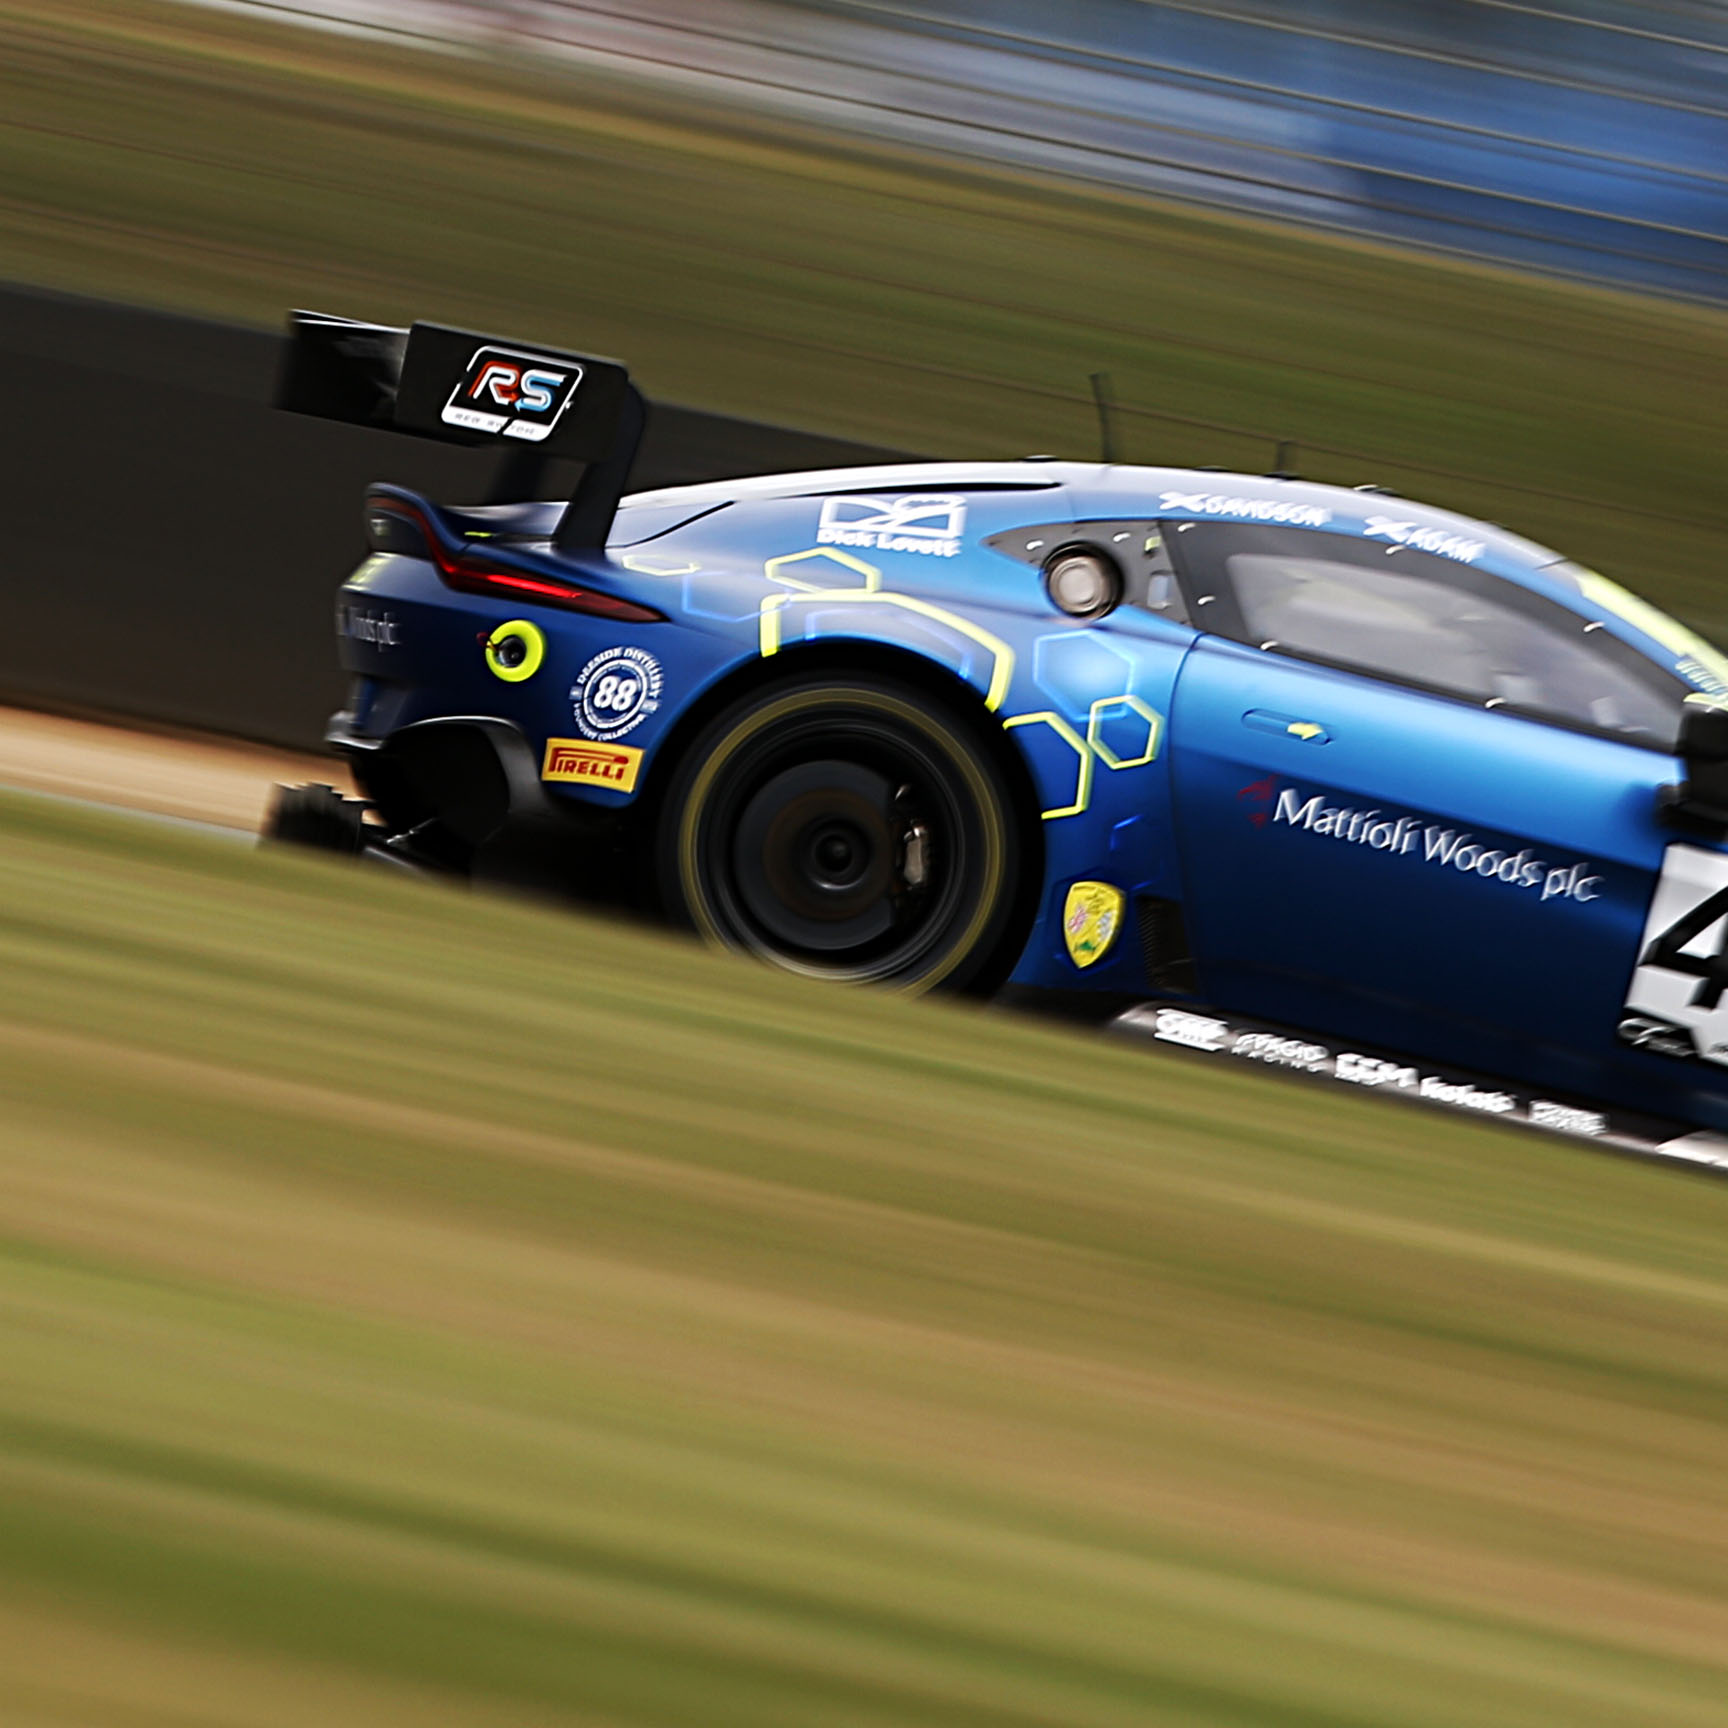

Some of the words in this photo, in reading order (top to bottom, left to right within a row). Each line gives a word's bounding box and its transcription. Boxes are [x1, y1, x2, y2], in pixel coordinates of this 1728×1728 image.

[467, 360, 568, 413] RS
[593, 675, 638, 712] 88
[549, 747, 629, 780] PIRELLI
[1273, 788, 1421, 855] Mattioli
[1424, 825, 1546, 888] Woods
[1540, 862, 1604, 903] plc
